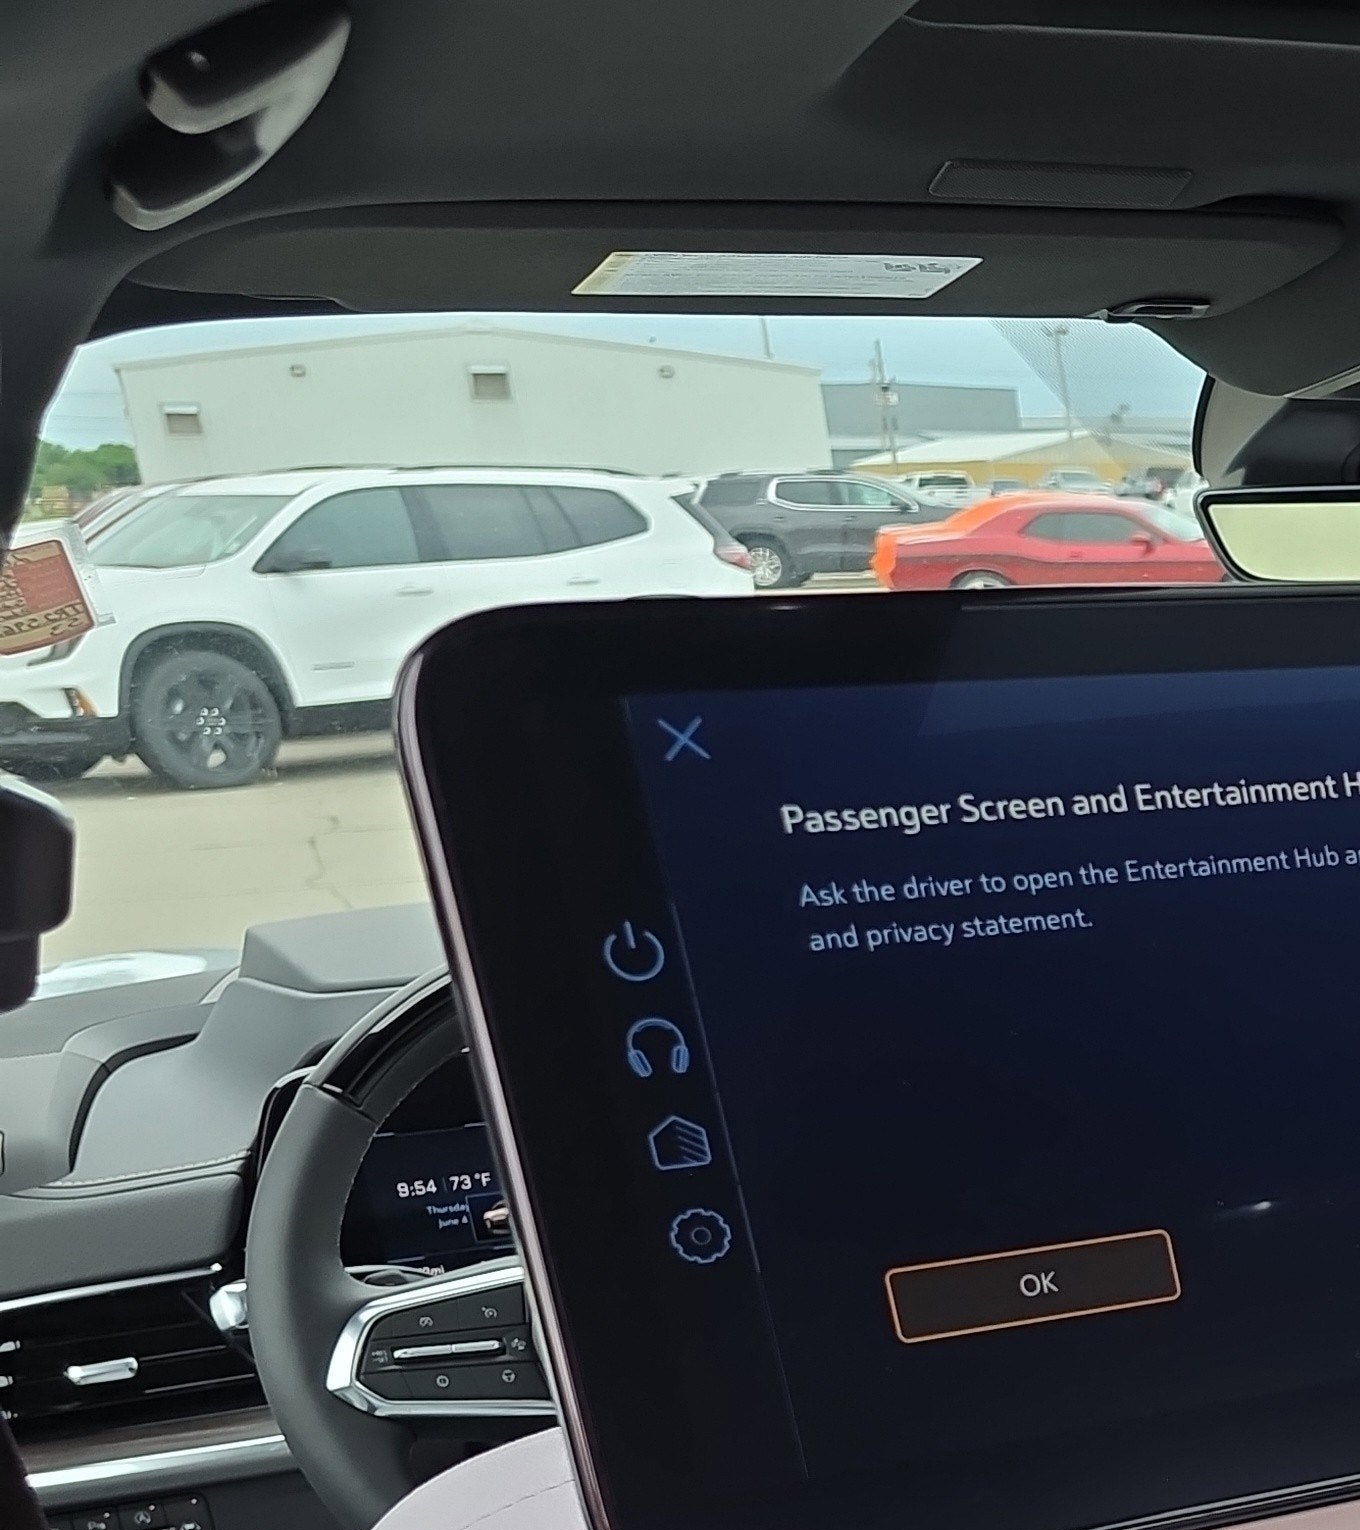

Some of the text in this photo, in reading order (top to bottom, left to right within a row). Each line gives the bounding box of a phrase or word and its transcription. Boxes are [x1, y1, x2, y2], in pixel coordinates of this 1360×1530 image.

[780, 802, 951, 835] Passenger
[958, 793, 1066, 824] Screen
[1071, 784, 1129, 816] and
[1133, 778, 1339, 812] Entertainment
[799, 881, 848, 907] Ask
[852, 878, 896, 904] the
[903, 874, 975, 901] driver
[979, 873, 1006, 894] to
[1013, 867, 1074, 895] open
[1078, 862, 1119, 886] the
[1124, 850, 1291, 883] Entertainment
[1294, 844, 1340, 868] Hub
[808, 908, 1094, 952] and privacy statement.
[396, 1178, 437, 1198] 9:54
[439, 1217, 460, 1230] June
